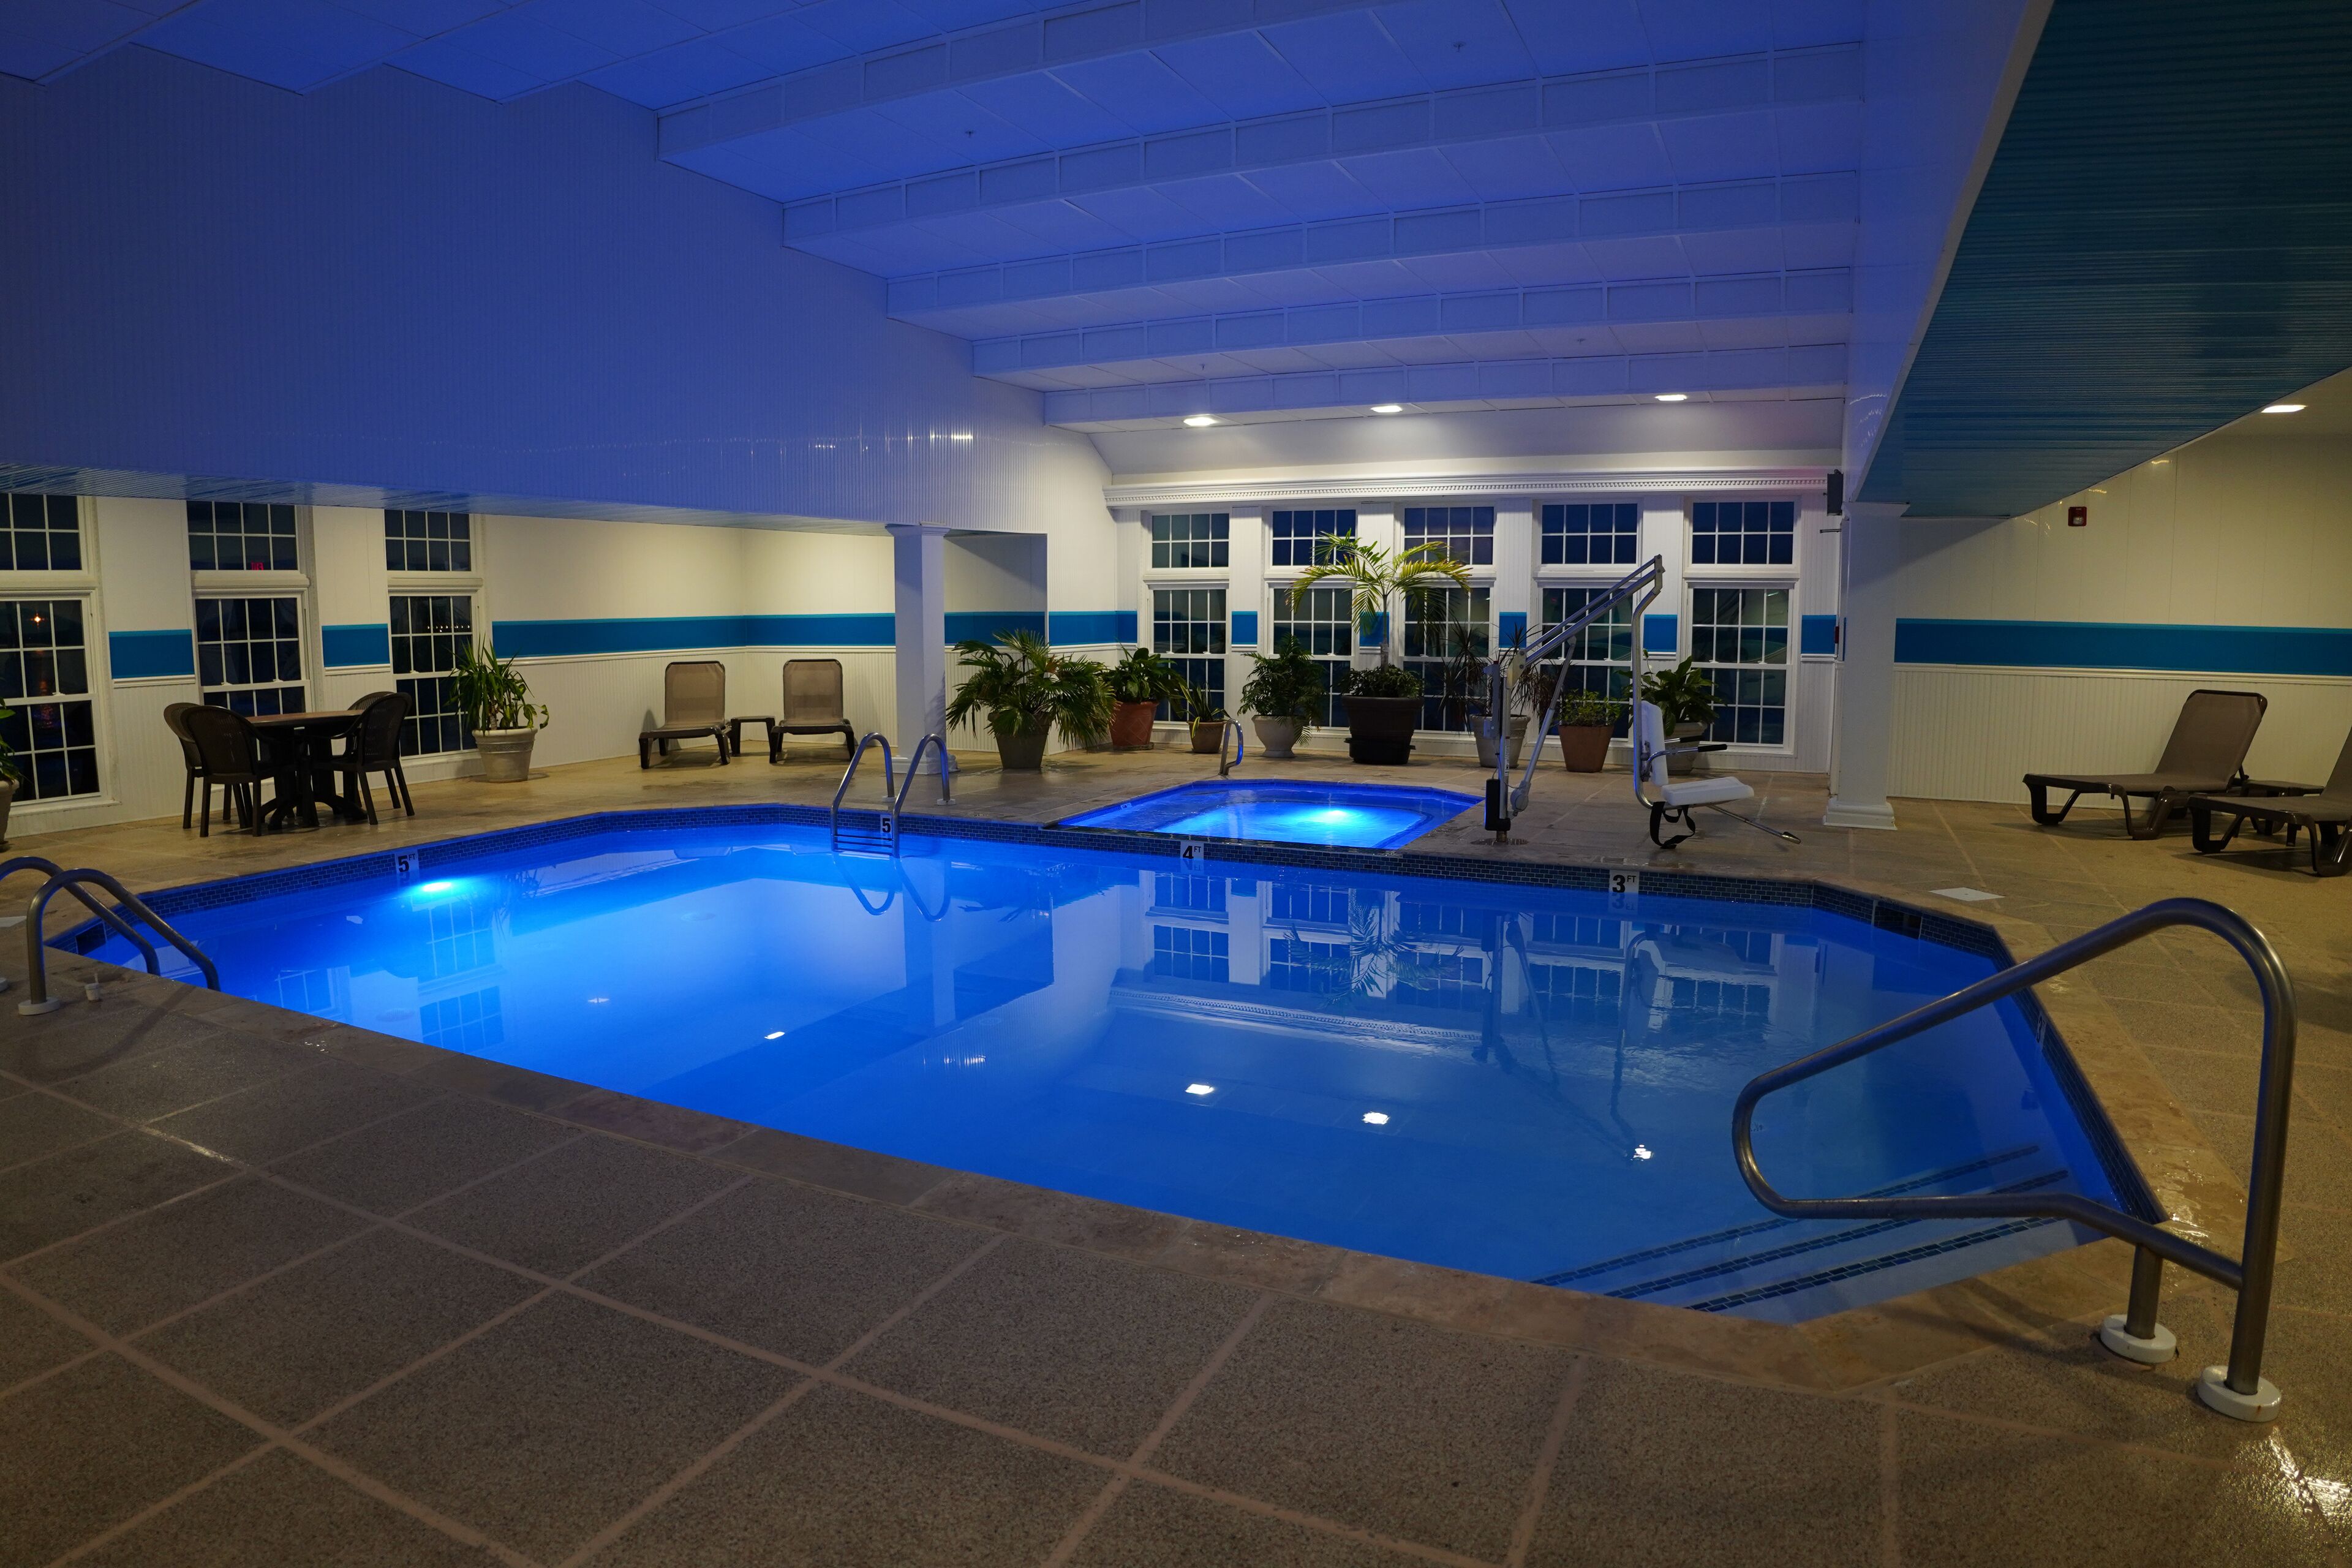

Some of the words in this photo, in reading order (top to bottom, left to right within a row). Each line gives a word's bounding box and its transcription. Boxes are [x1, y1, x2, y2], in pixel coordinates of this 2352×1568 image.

[882, 818, 891, 833] 5
[1182, 845, 1194, 859] 4
[398, 855, 410, 873] 5
[1612, 875, 1626, 893] 3
